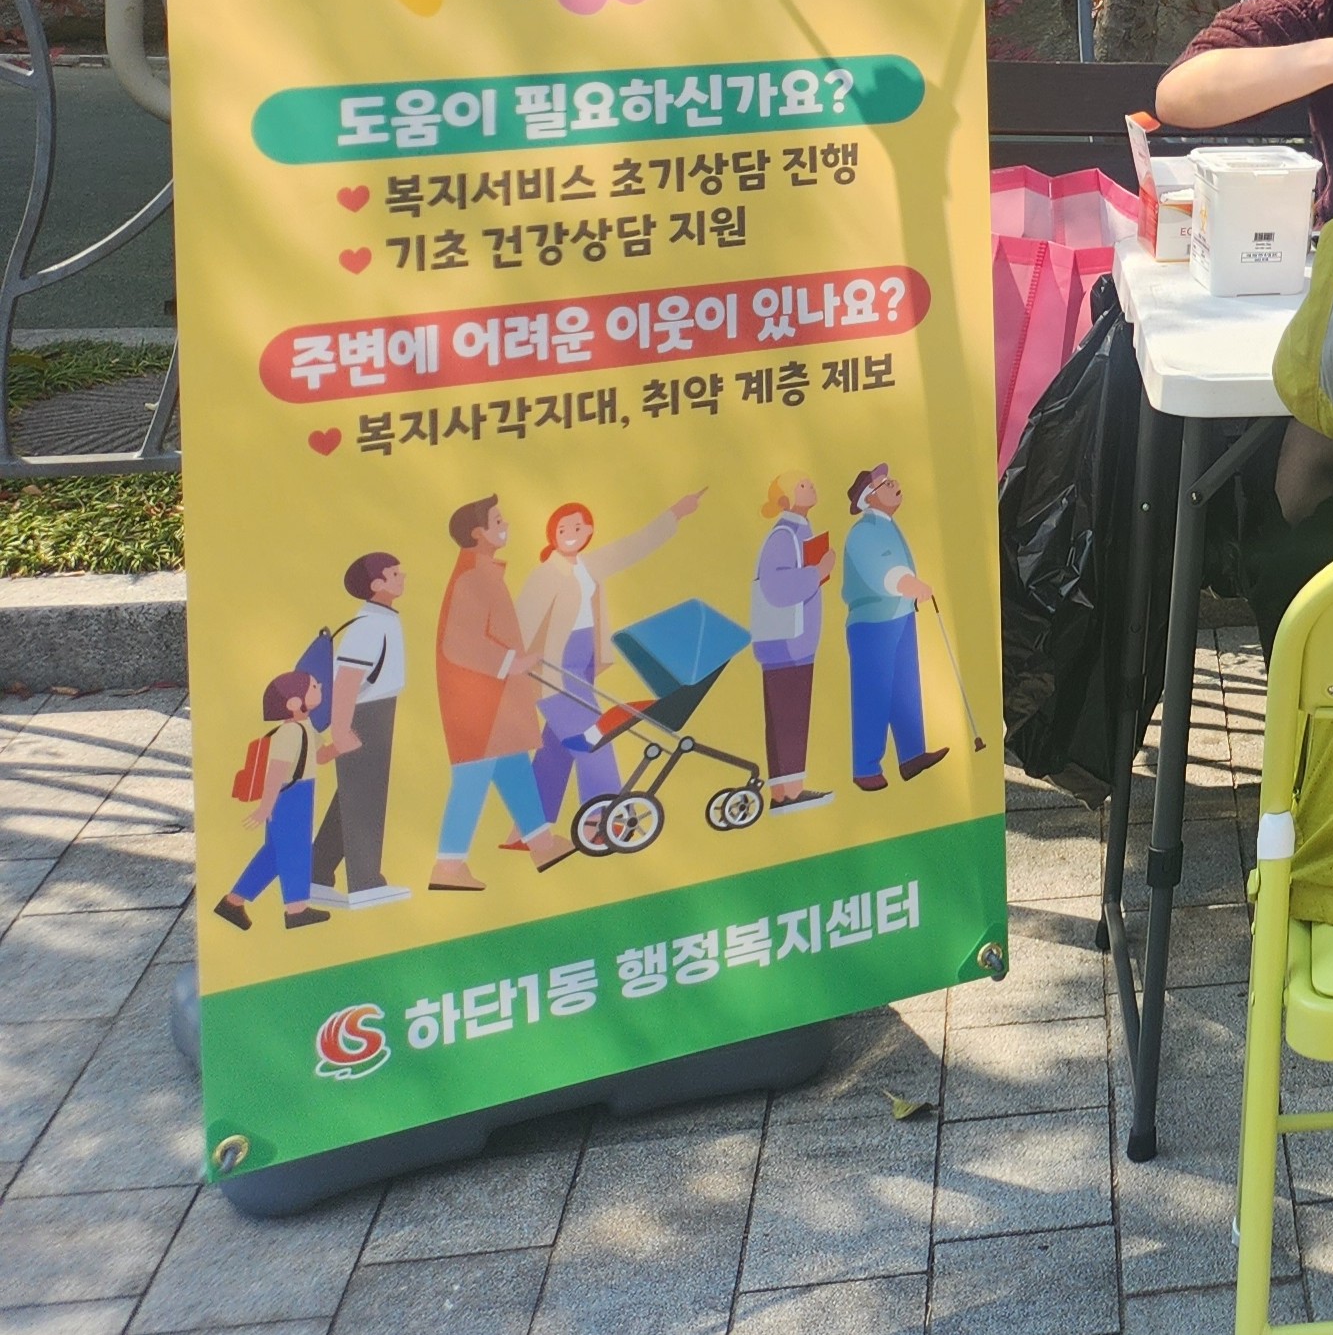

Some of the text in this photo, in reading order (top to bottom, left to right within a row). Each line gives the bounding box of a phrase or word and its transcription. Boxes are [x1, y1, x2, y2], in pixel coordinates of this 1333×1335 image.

[336, 68, 855, 148] 도움이 필요하신가요?
[384, 142, 861, 218] 복지서비스 초기상담 진행
[385, 205, 749, 273] 기초 건강상담 지원
[289, 276, 908, 391] 주변에 어려운 이웃이 있나요?
[354, 351, 898, 457] 복지사각지대, 취약 계층 제보
[404, 879, 923, 1051] 하단1동 행정복지센터
